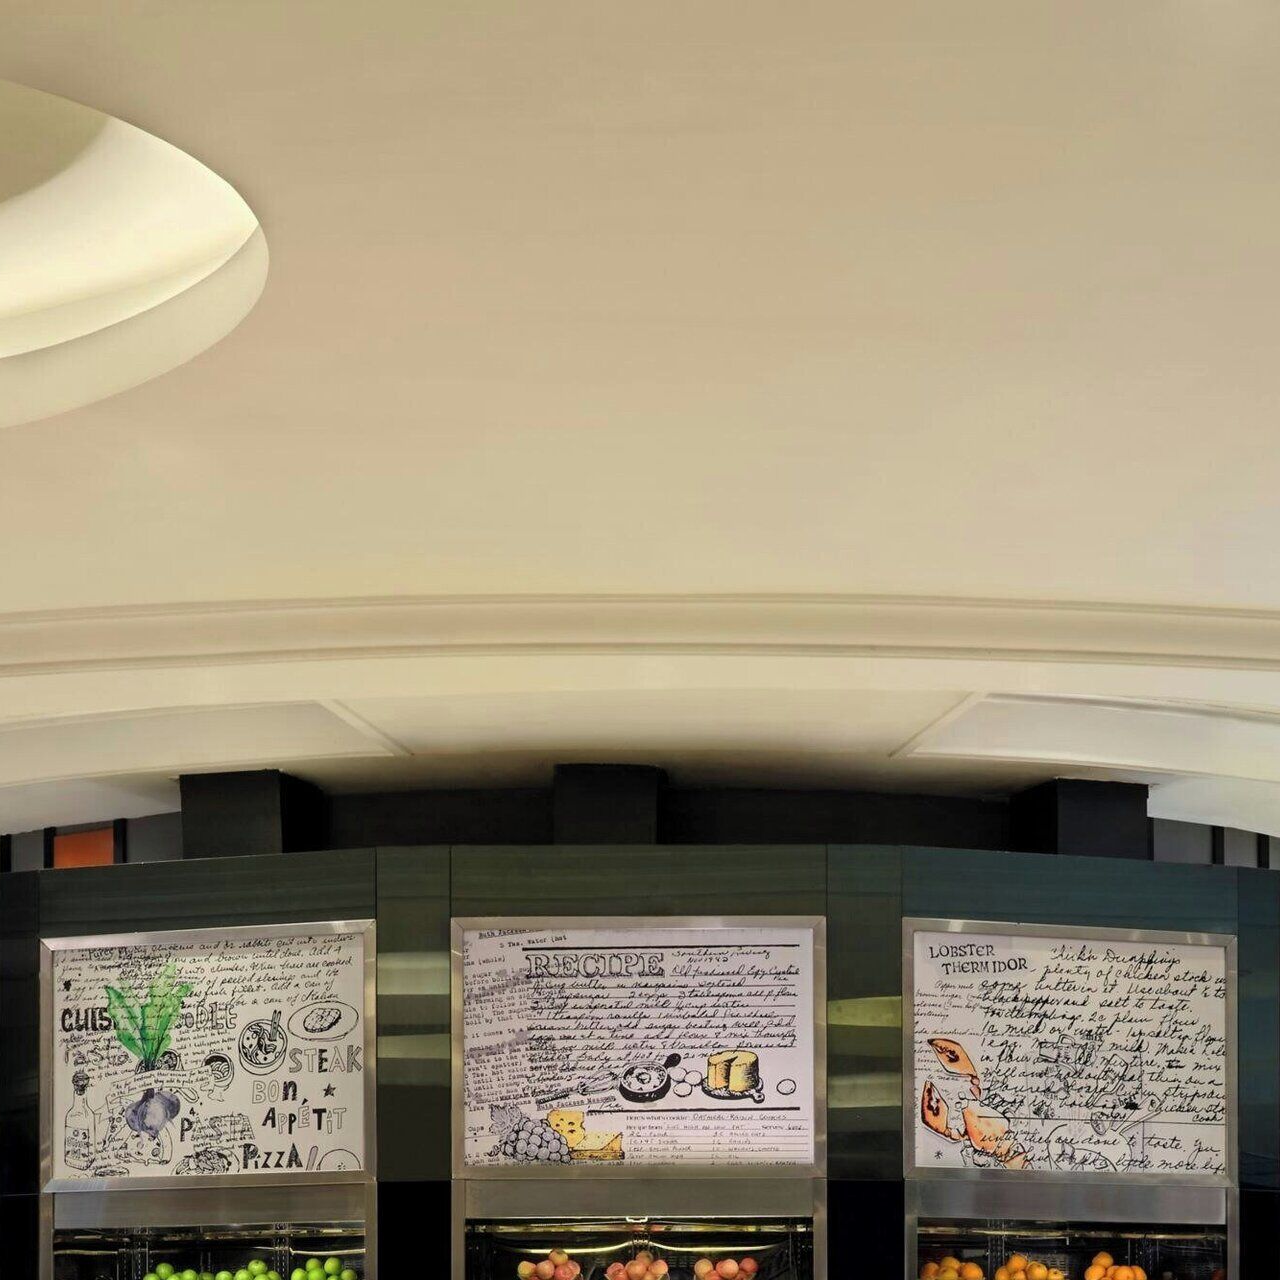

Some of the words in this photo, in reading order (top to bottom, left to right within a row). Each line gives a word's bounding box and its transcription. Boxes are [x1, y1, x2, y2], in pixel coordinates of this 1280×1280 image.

[929, 943, 996, 959] LOBSTER
[525, 952, 666, 979] RECIPE
[941, 957, 1029, 976] THERMIDOR
[289, 1045, 362, 1073] STEAK
